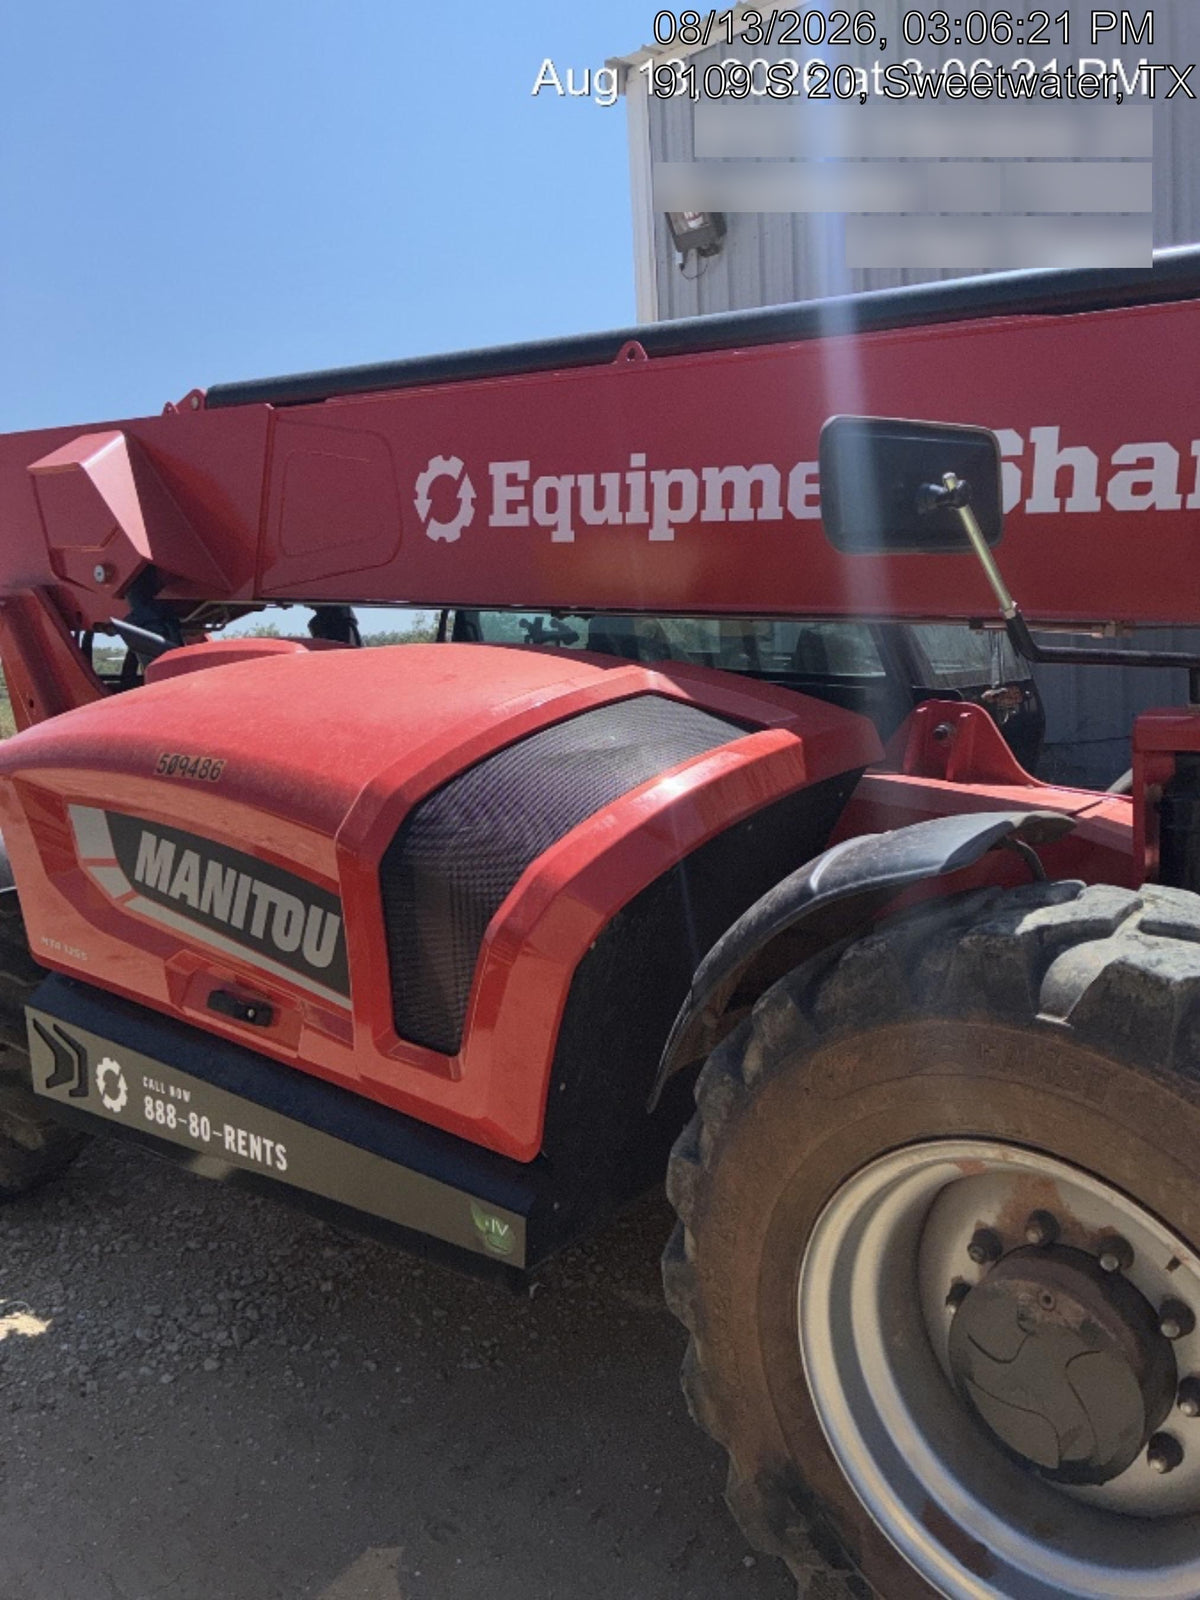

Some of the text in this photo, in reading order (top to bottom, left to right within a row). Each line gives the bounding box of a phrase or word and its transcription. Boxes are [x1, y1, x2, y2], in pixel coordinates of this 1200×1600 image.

[156, 753, 225, 781] 509486
[134, 830, 341, 968] MANITOU
[143, 1076, 191, 1103] CALL NOW
[143, 1095, 288, 1171] 888-80-RENTS
